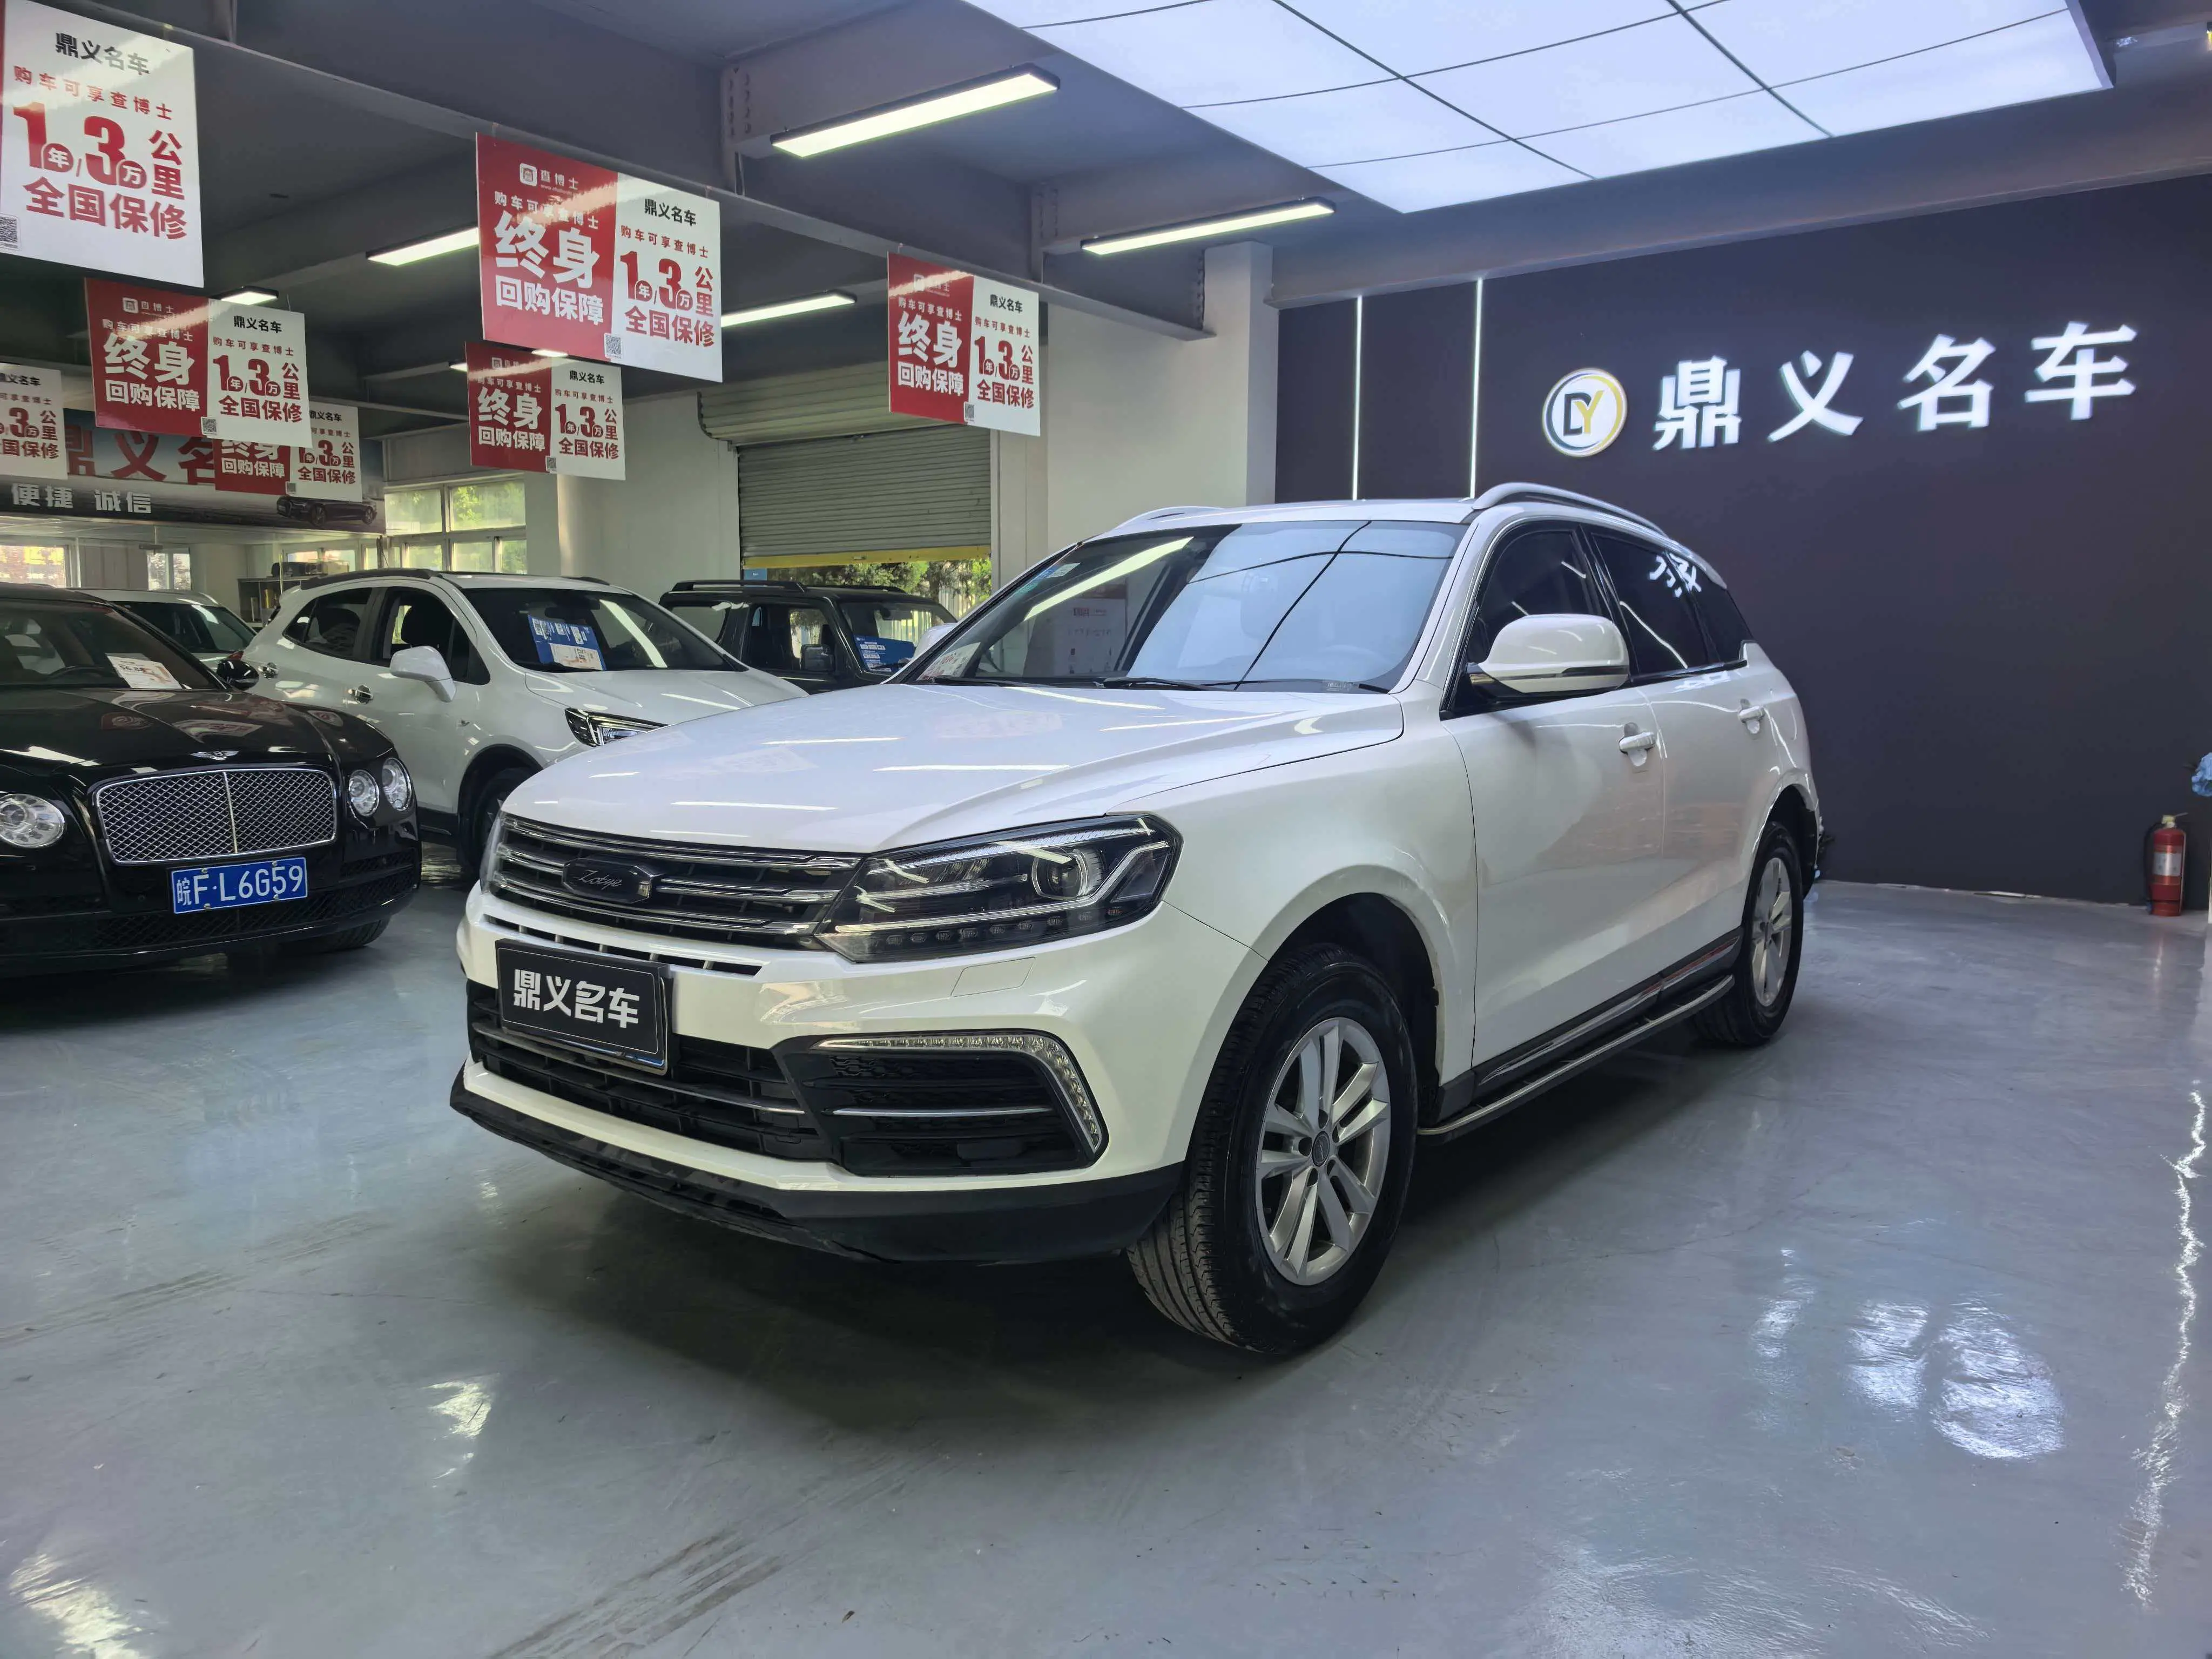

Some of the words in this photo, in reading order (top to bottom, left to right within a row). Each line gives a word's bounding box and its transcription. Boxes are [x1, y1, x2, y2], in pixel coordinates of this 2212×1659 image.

[56, 32, 150, 76] 鼎义名车
[14, 65, 173, 120] 购车可享查博士
[23, 176, 187, 240] 全国保修
[644, 198, 697, 226] 鼎义名车
[494, 210, 599, 289] 终身
[621, 225, 709, 259] 购车可享查博士
[495, 275, 604, 326] 回购保障
[990, 294, 1023, 313] 鼎义名车
[233, 315, 282, 334] 鼎义名车
[625, 305, 715, 347] 全国保修
[898, 311, 963, 368] 终身
[103, 332, 194, 385] 终身
[213, 336, 294, 356] 购车可享查博士
[570, 370, 605, 385] 鼎义名车
[898, 361, 963, 397] 回购保障
[977, 379, 1035, 409] 全国保修
[1651, 320, 2137, 450] 鼎义名车
[105, 379, 200, 413] 回购保障
[219, 395, 303, 423] 全国保修
[477, 387, 542, 430] 终身
[0, 439, 59, 459] 国保修
[478, 426, 545, 451] 回购保障
[559, 437, 619, 460] 全国保修
[221, 457, 285, 478] 回购保障
[298, 466, 355, 484] 全国保修
[11, 483, 73, 508] 便捷
[94, 489, 152, 514] 诚信
[514, 969, 640, 1028] 鼎义名车
